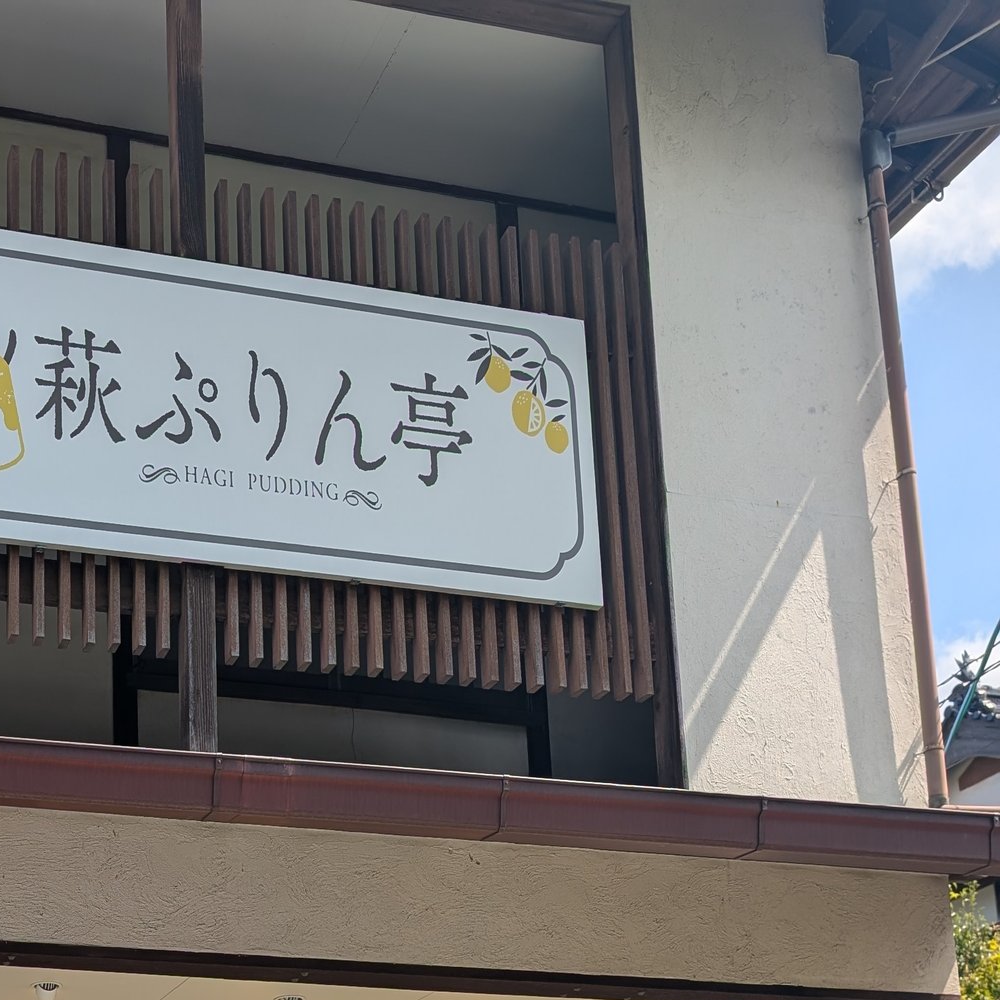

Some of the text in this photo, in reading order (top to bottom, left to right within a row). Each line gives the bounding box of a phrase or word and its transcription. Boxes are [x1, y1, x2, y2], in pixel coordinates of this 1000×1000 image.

[35, 326, 473, 487] 萩ぷりん亭
[183, 465, 341, 502] HAGI PUDDING
